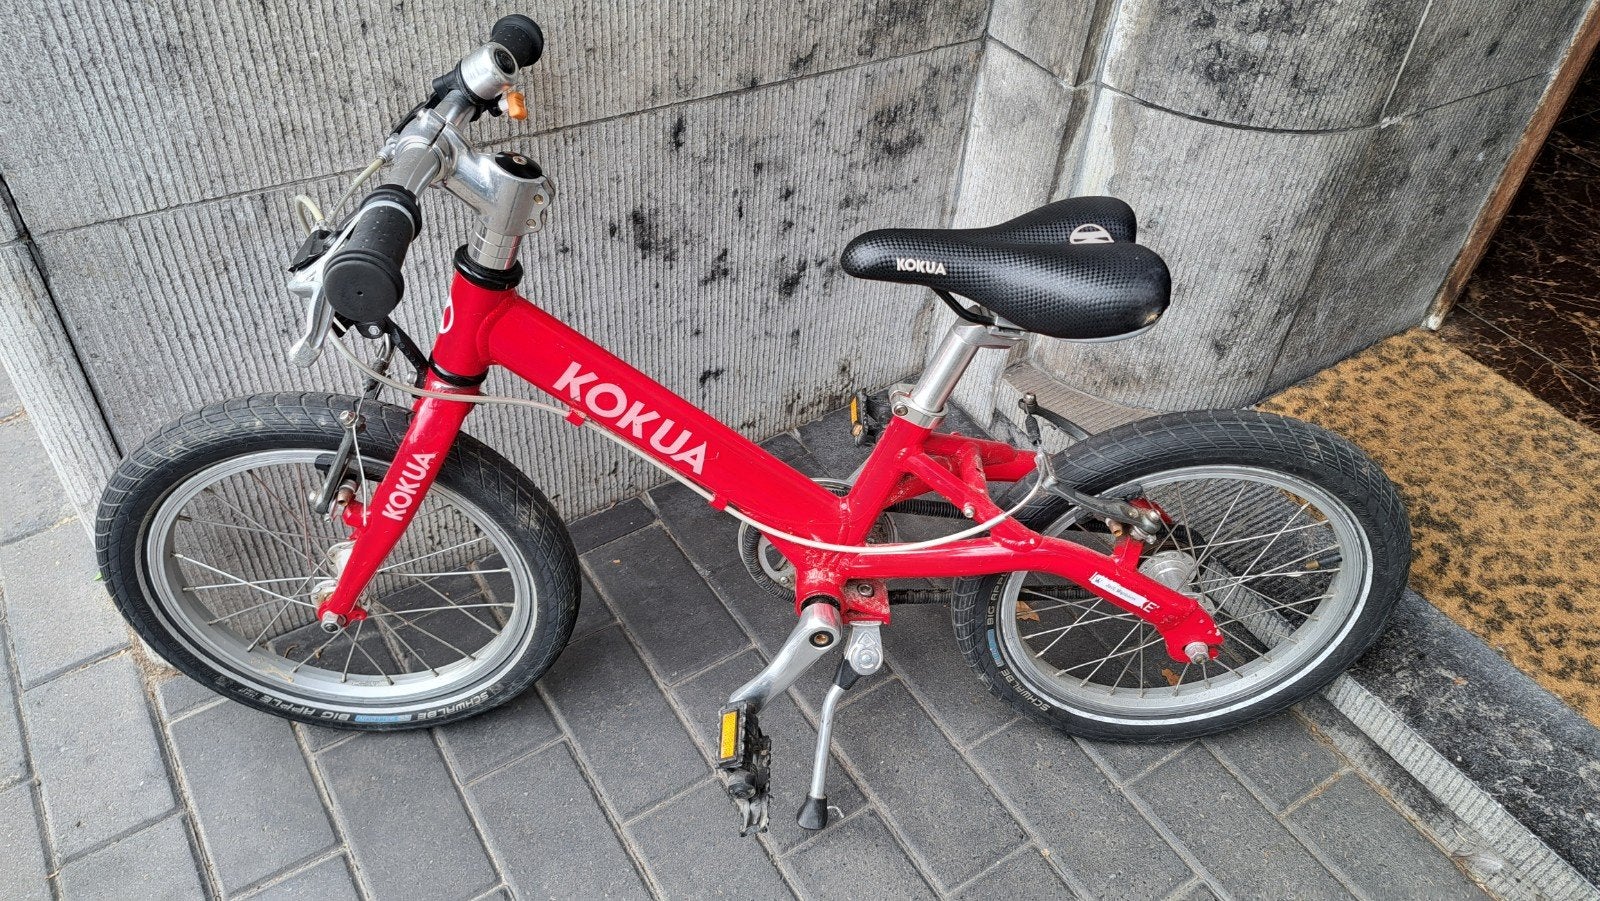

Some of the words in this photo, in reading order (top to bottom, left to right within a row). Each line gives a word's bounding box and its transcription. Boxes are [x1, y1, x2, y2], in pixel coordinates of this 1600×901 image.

[896, 258, 947, 277] KOKUA
[552, 361, 708, 475] KOKUA
[381, 451, 437, 522] KOKUA
[990, 572, 1008, 601] APPL
[986, 605, 996, 626] BIG
[1001, 668, 1051, 712] SCHWALBE
[259, 694, 315, 716] APPLE
[320, 711, 351, 721] BIG
[417, 690, 489, 721] SCHWALBE
